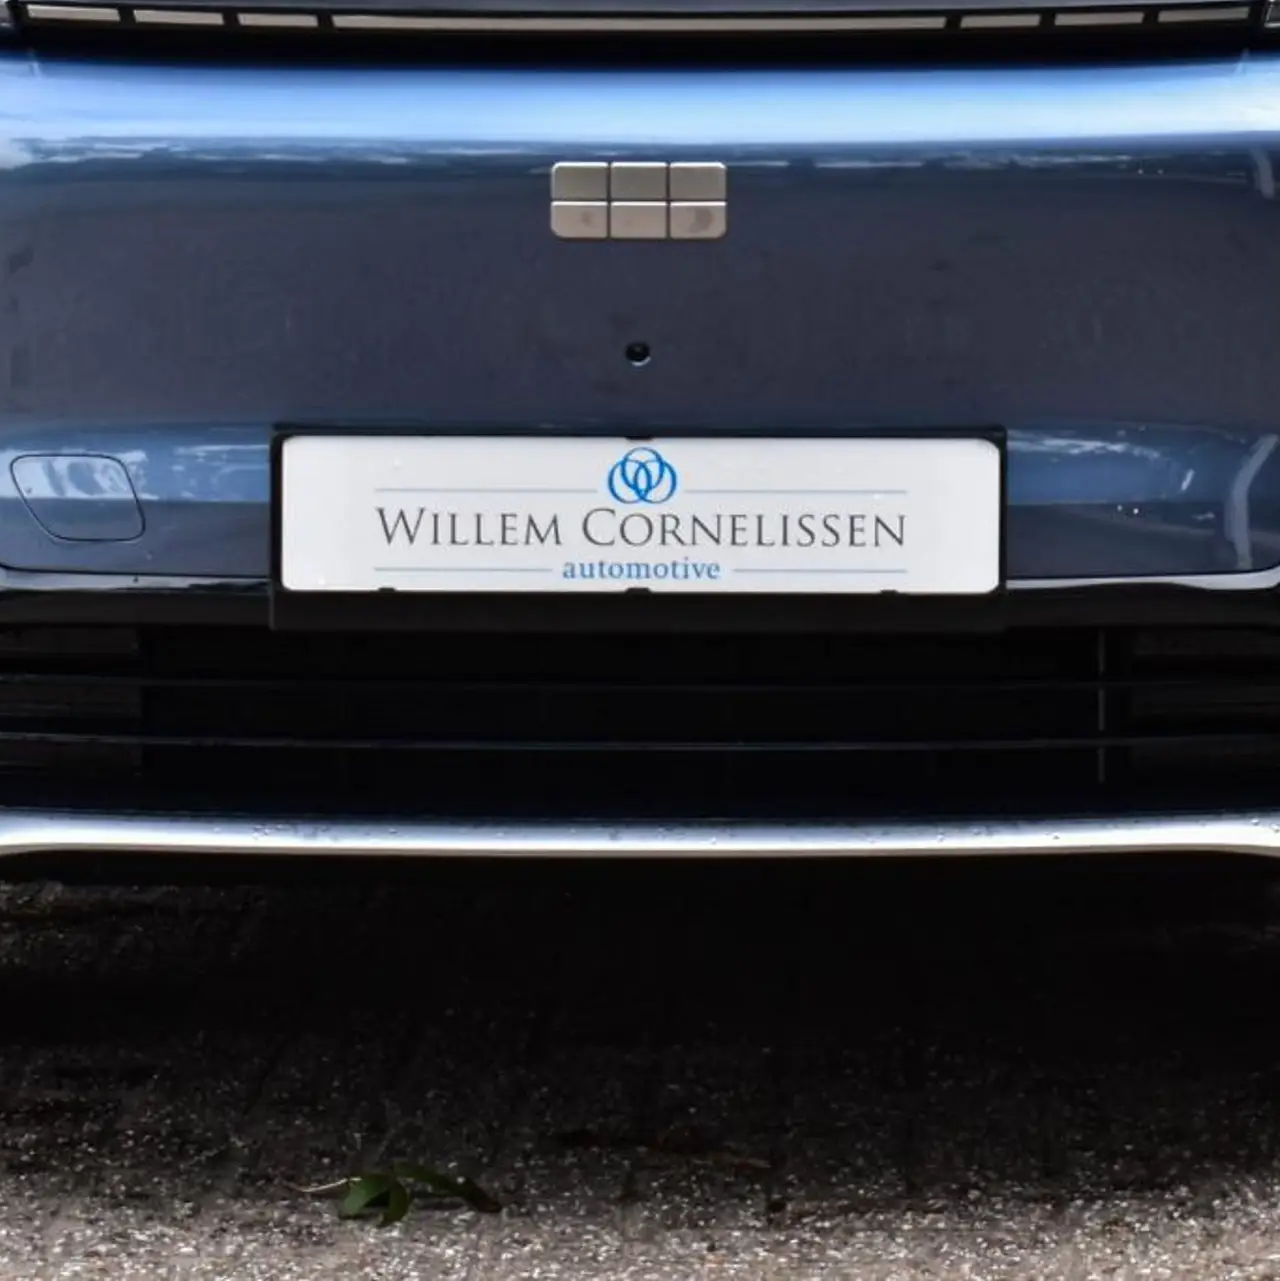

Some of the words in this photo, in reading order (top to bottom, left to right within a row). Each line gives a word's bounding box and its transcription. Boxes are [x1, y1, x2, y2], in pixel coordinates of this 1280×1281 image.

[375, 506, 563, 546] WILLEM
[581, 507, 906, 547] CORNELISSEN
[561, 555, 721, 581] automotive
